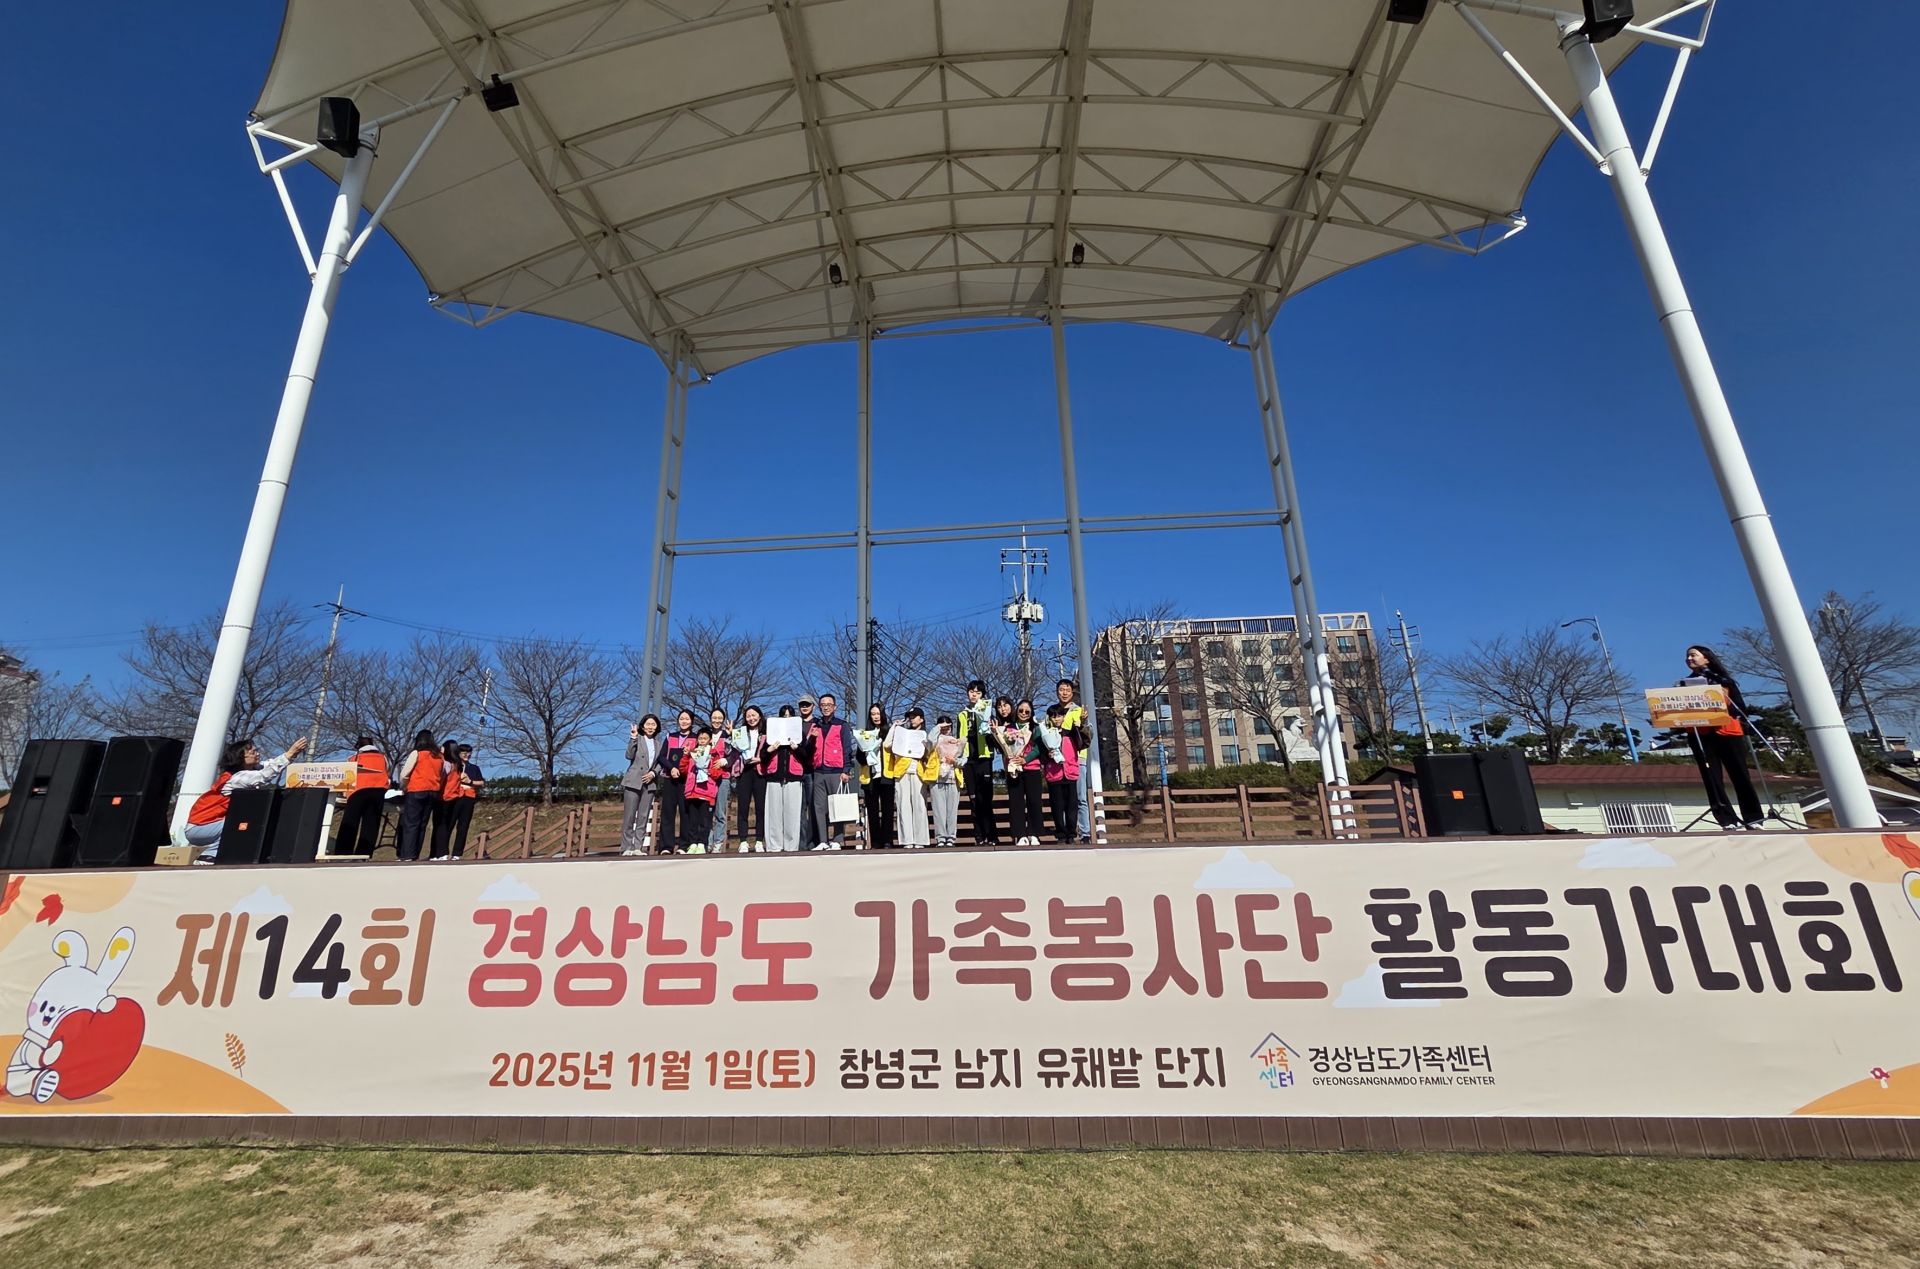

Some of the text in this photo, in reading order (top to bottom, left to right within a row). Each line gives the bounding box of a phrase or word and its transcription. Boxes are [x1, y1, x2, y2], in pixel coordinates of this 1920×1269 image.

[156, 880, 1904, 1008] 제14회 경상남도 가족봉사단 활동가대회
[488, 1046, 1227, 1091] 2025년 11월 1일(토) 창녕군 남지 유채밭 단지
[1257, 1047, 1289, 1071] 가족
[1308, 1044, 1493, 1073] 경상남도가족센터
[1259, 1068, 1294, 1089] 센터
[1312, 1076, 1496, 1086] GYEONGSANGNAMDO FAMILY CENTER
